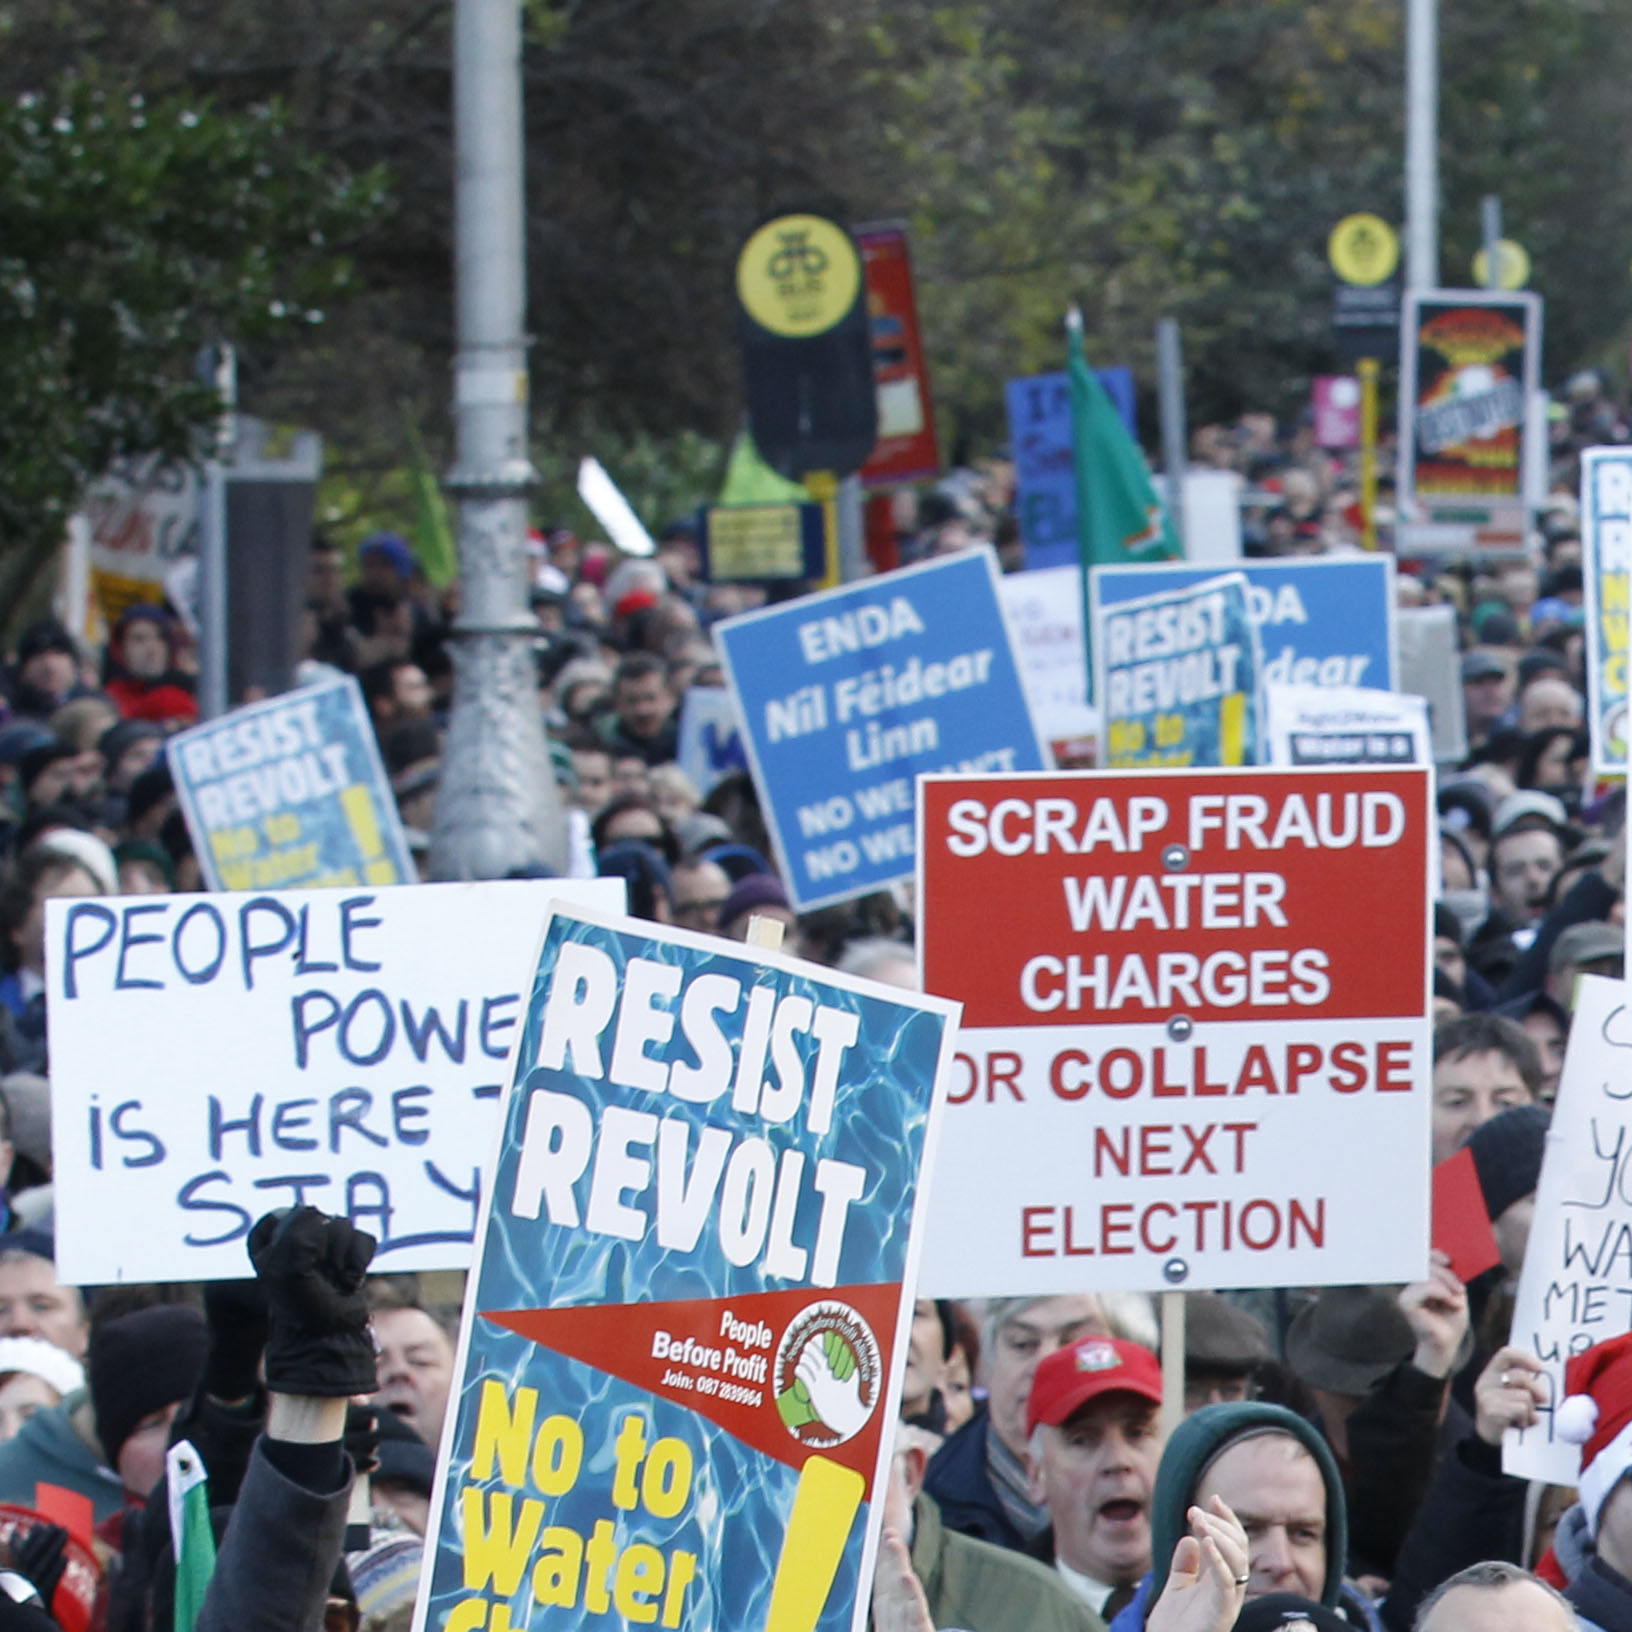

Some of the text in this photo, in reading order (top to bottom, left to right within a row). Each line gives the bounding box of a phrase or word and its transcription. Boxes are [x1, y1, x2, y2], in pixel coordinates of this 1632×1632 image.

[798, 597, 926, 665] ENDA
[1108, 592, 1227, 663] RESIST
[1108, 645, 1242, 718] REVOLT
[183, 702, 323, 783] RESIST
[846, 717, 940, 772] Linn
[1109, 721, 1146, 752] No
[195, 741, 350, 830] REVOLT
[797, 778, 913, 838] NO WE
[946, 791, 1406, 857] SCRAP FRAUD
[803, 840, 860, 880] NO
[1063, 871, 1289, 932] WATER
[64, 896, 383, 999] PEOPLE
[1019, 948, 1332, 1012] CHARGES
[292, 989, 519, 1069] POWE
[538, 941, 860, 1135] RESIST
[946, 1041, 1414, 1103] OR COLLAPSE
[209, 1085, 434, 1161] HERE
[1094, 1122, 1258, 1178] NEXT
[511, 1089, 866, 1289] REVOLT
[1021, 1198, 1326, 1258] ELECTION
[651, 1330, 769, 1384] Before Profit
[720, 1309, 773, 1350] People
[661, 1368, 694, 1391] Join:
[471, 1378, 694, 1519] No to
[461, 1486, 698, 1630] Water
